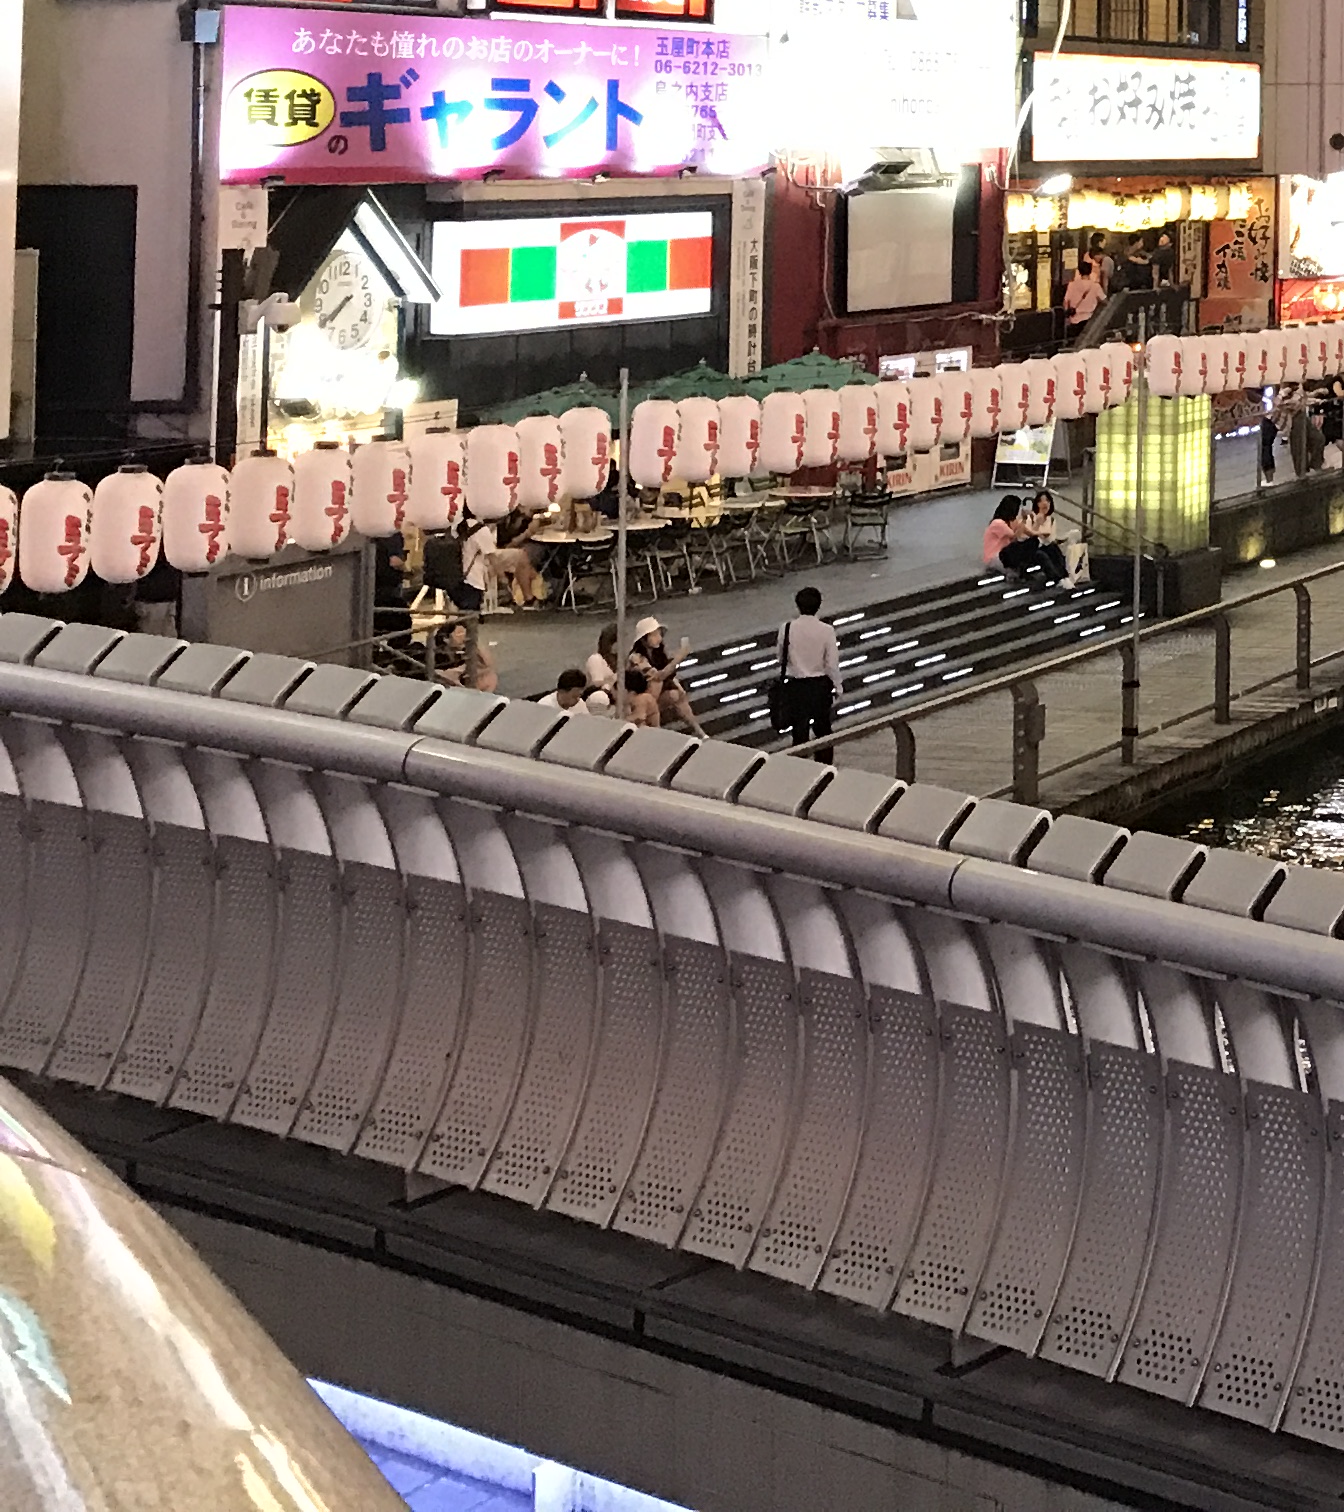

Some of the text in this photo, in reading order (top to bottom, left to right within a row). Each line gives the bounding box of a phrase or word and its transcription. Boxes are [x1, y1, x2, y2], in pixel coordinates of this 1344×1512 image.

[290, 27, 642, 69] あなたも憧れのお店のオーナーに!
[654, 36, 731, 60] 玉屋町本店
[654, 59, 763, 77] 06-6212-3013
[242, 88, 324, 129] 賃貸
[327, 133, 348, 155] の
[339, 67, 644, 153] ギャラント
[939, 461, 965, 477] KIRIN
[259, 564, 334, 591] information
